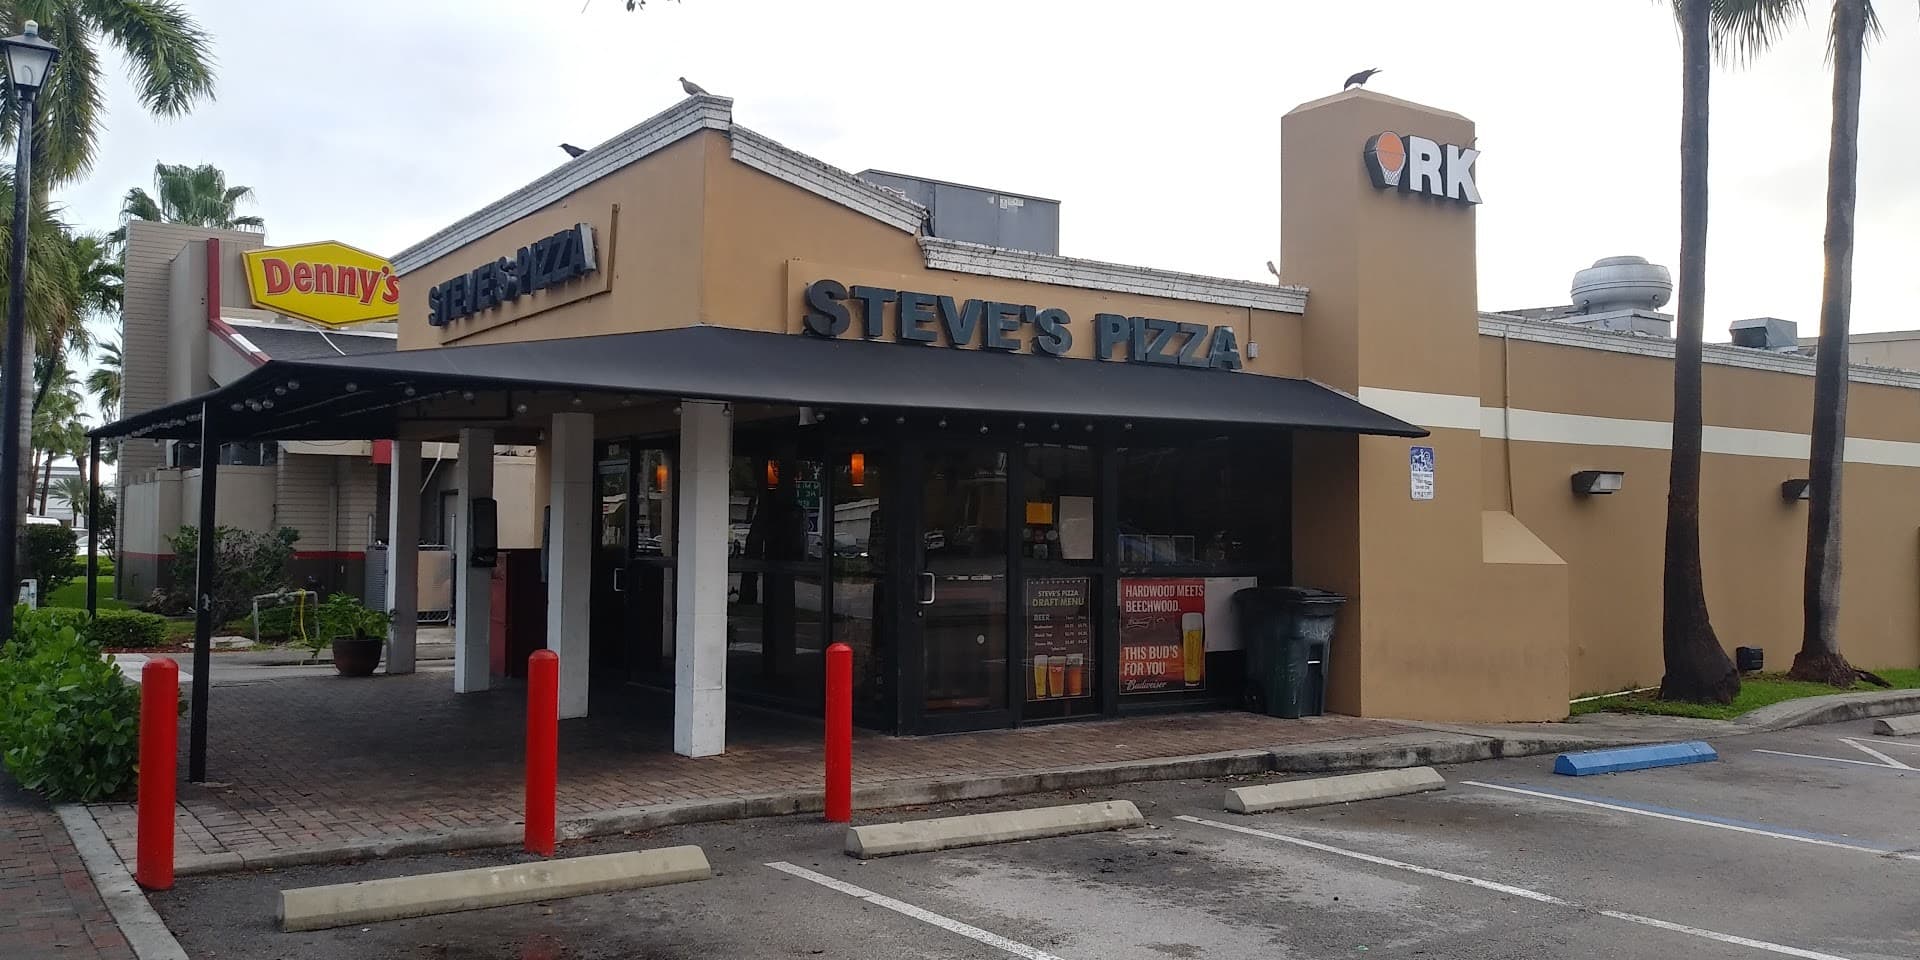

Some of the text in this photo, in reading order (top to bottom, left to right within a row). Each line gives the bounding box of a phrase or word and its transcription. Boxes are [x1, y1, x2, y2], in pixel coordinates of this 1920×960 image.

[262, 258, 399, 304] Denny's
[428, 222, 597, 327] STEVE'S PIZZA
[804, 280, 1242, 371] STEVE'S PIZZA
[1061, 589, 1079, 597] PIZZA
[1125, 585, 1204, 598] HARDWOOD MEETS
[1032, 598, 1085, 607] DRAFT MENU
[1125, 600, 1181, 613] BEECHWOOD.
[1124, 645, 1178, 660] THIS BUD'S
[1124, 662, 1166, 676] FOR YOU
[1126, 679, 1168, 691] Budweiser
